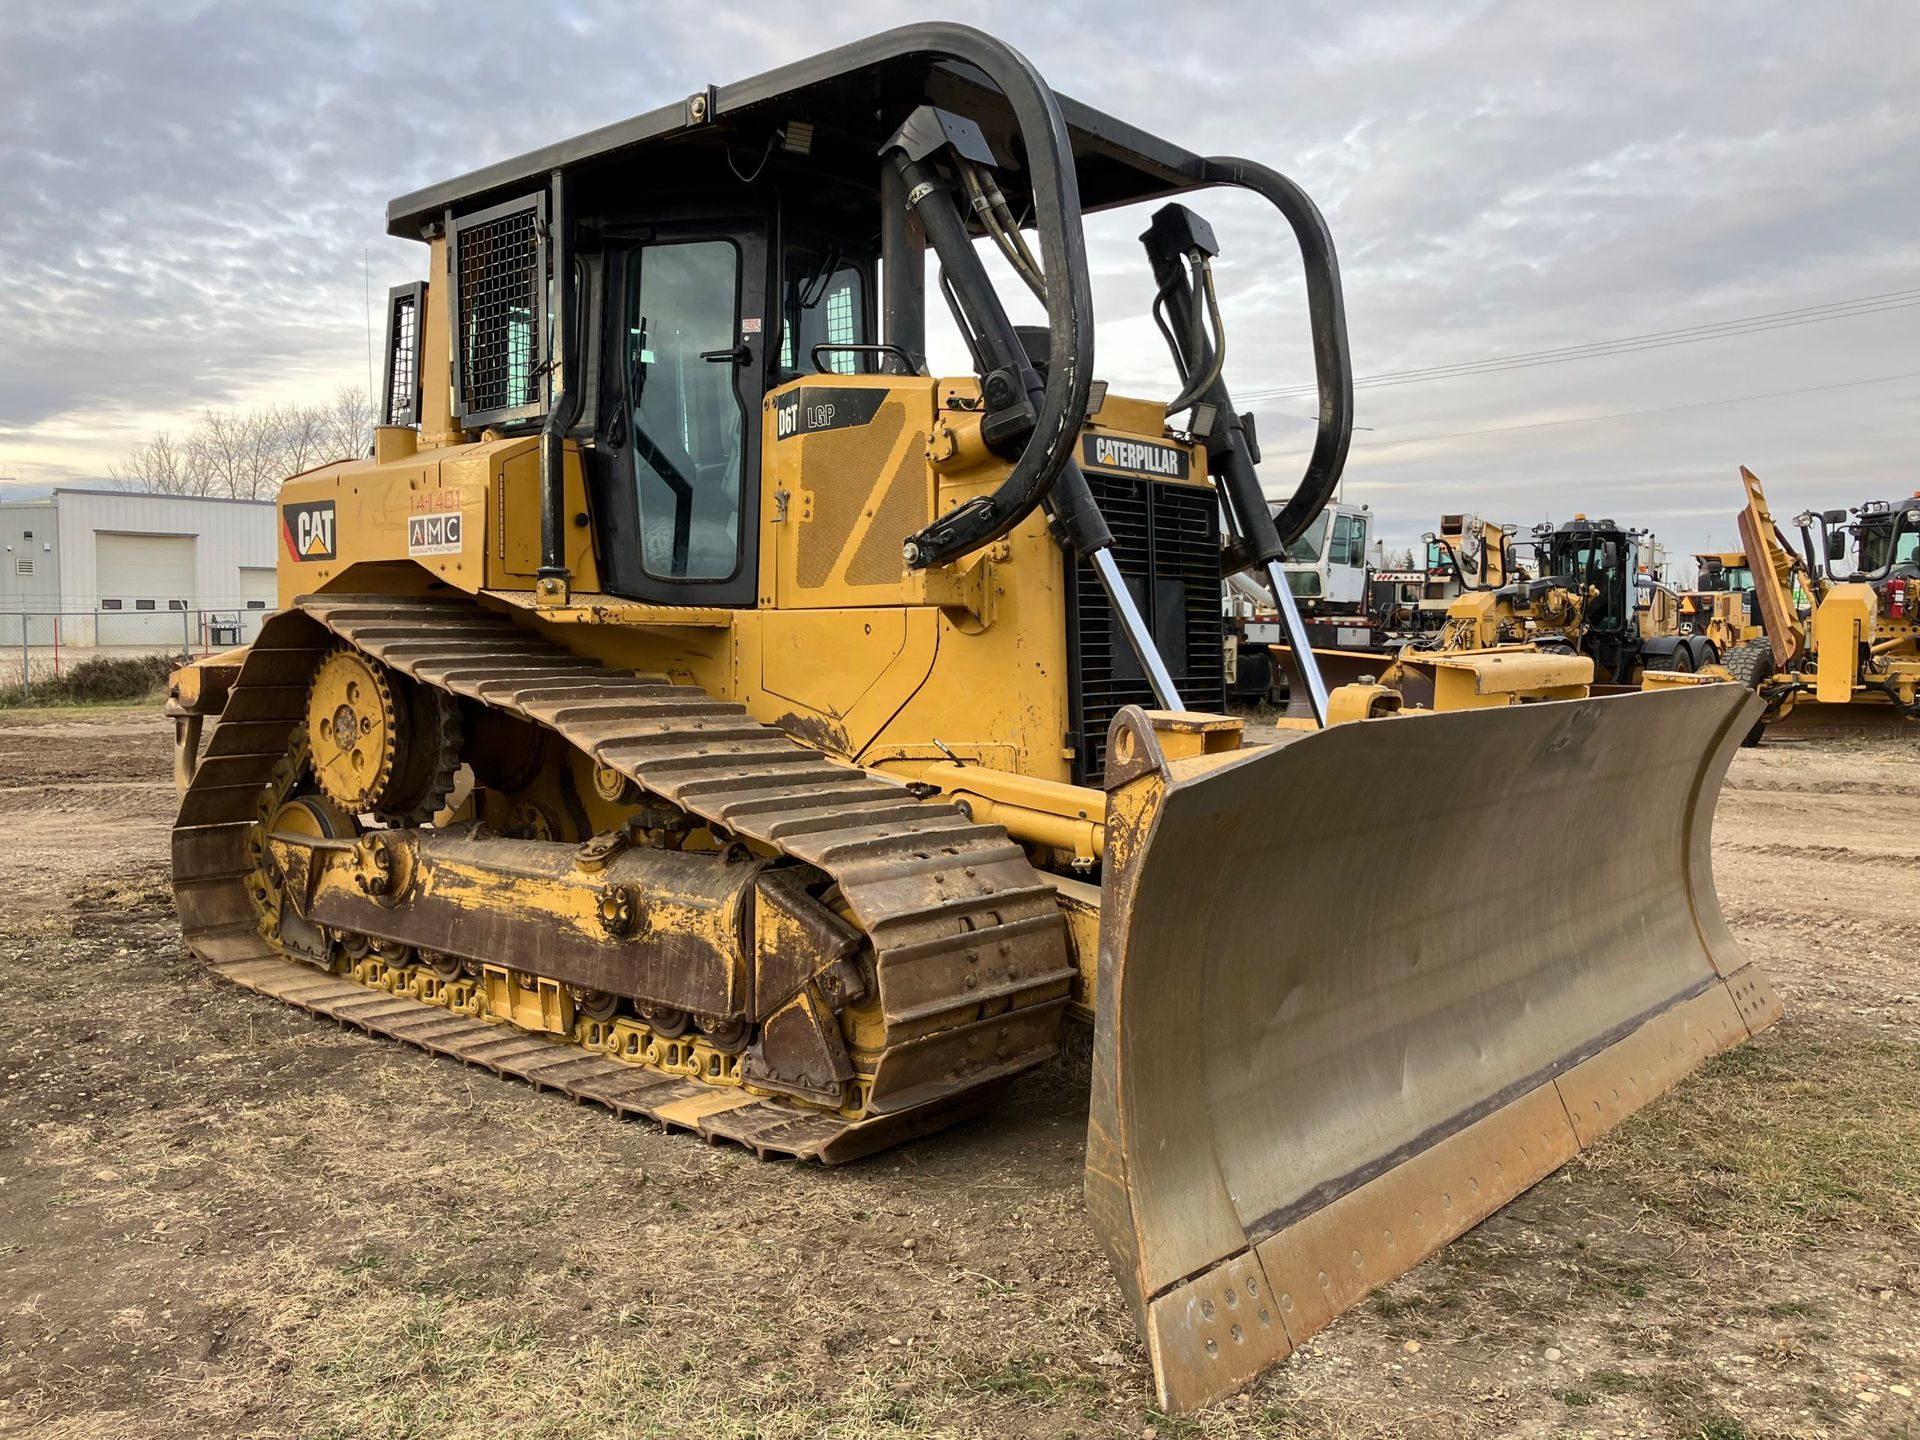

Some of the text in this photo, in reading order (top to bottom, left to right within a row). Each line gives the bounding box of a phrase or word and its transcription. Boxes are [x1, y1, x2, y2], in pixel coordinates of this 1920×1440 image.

[778, 404, 835, 436] D6T LGP
[1096, 438, 1178, 475] CATERPILLAR
[297, 509, 334, 556] CAT
[411, 518, 458, 545] AMC
[1637, 587, 1651, 606] CAT
